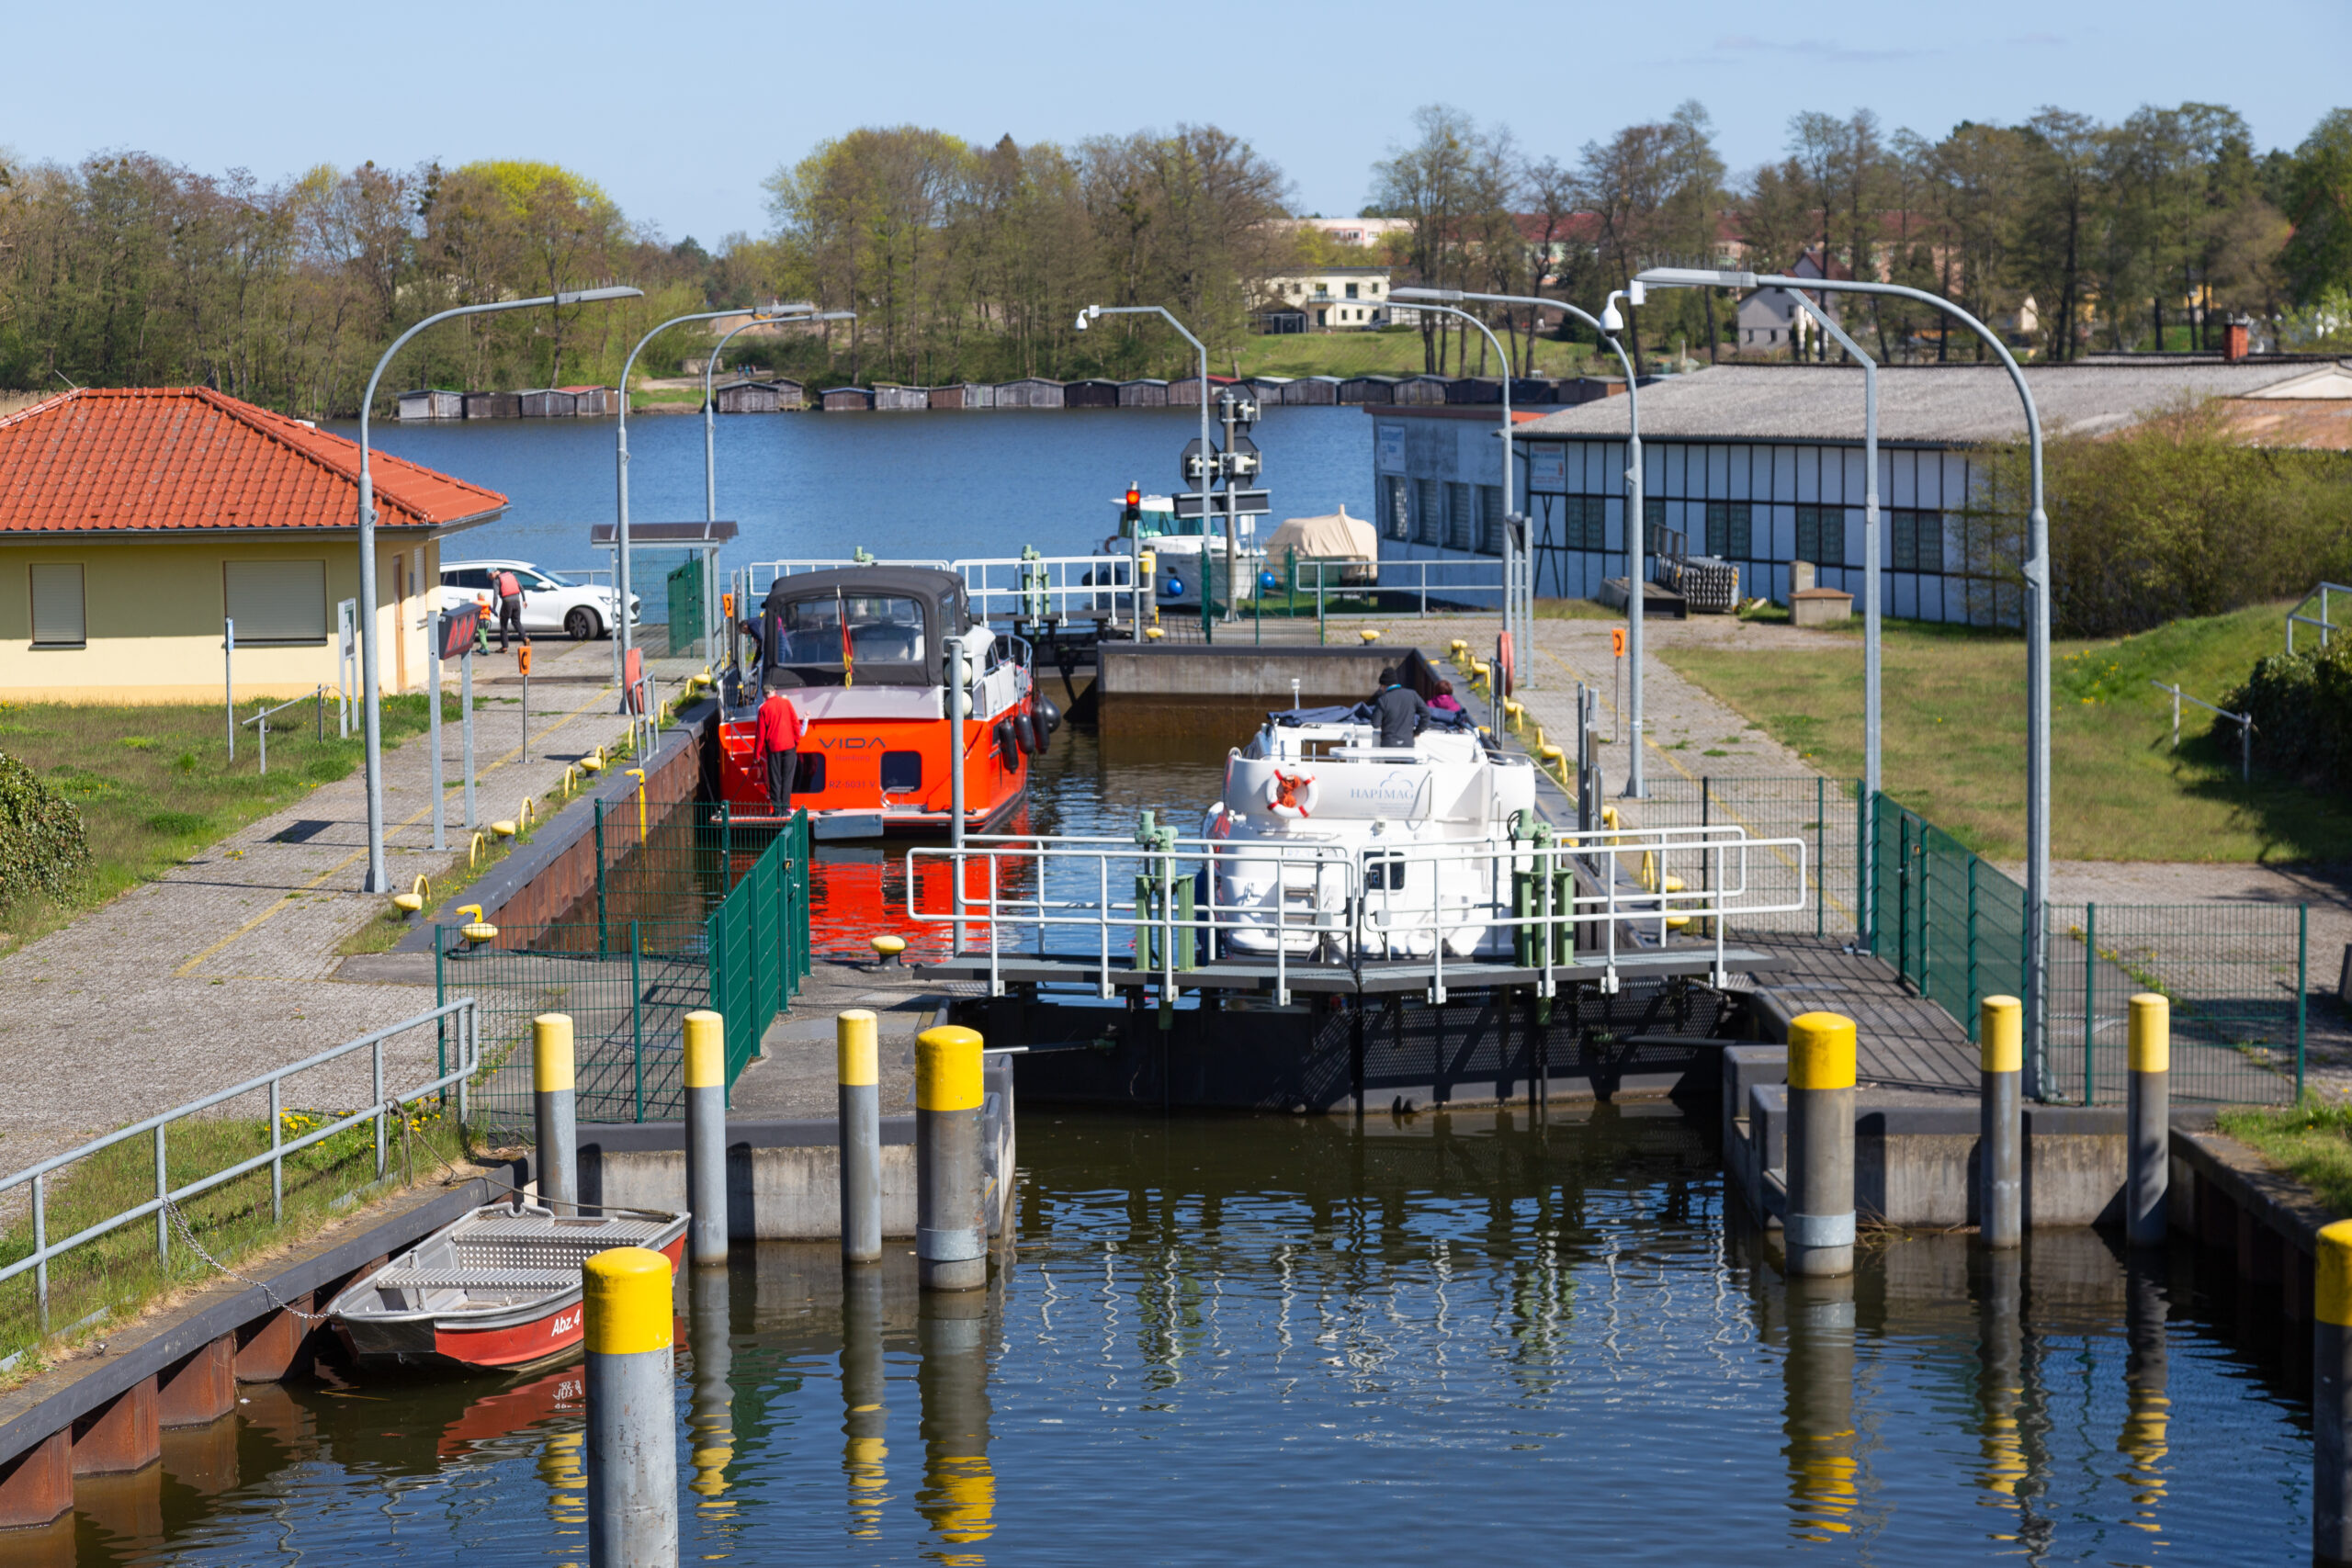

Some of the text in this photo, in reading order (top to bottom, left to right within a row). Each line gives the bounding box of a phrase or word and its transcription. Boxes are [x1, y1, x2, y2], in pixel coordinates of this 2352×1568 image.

[819, 738, 887, 749] VIDA
[1351, 788, 1414, 799] HAPIMAG
[551, 1309, 581, 1337] Abz. 4
